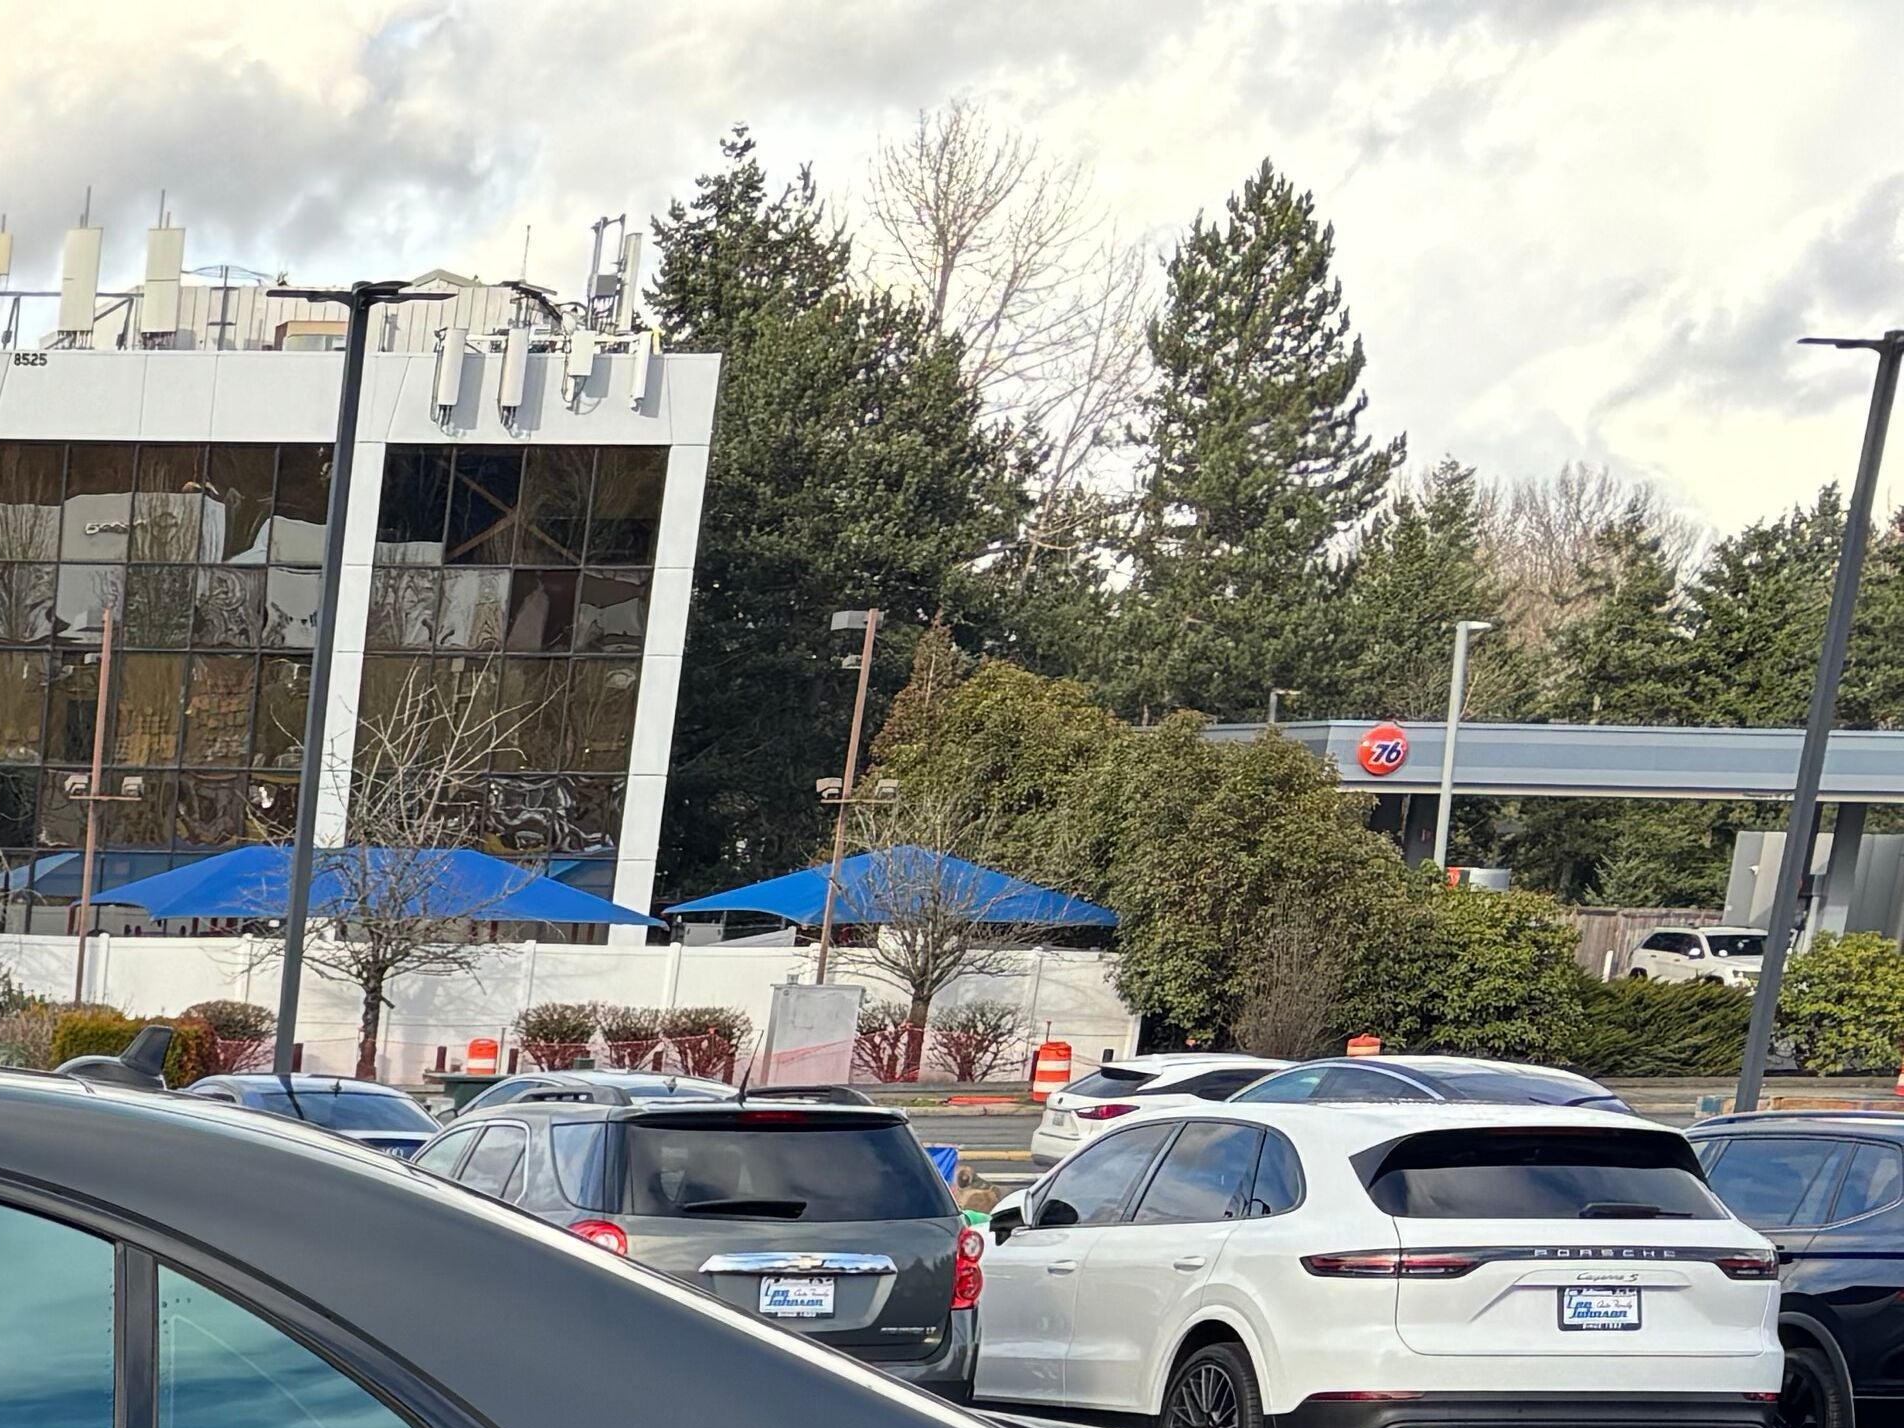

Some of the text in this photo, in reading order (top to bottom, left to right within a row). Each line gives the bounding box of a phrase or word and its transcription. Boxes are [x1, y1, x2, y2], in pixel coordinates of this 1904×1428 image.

[14, 352, 48, 366] 8525
[1370, 740, 1403, 765] 76
[1534, 1248, 1676, 1258] PORSCHE
[1576, 1272, 1624, 1282] Cayenne
[1569, 1306, 1628, 1319] Johnson
